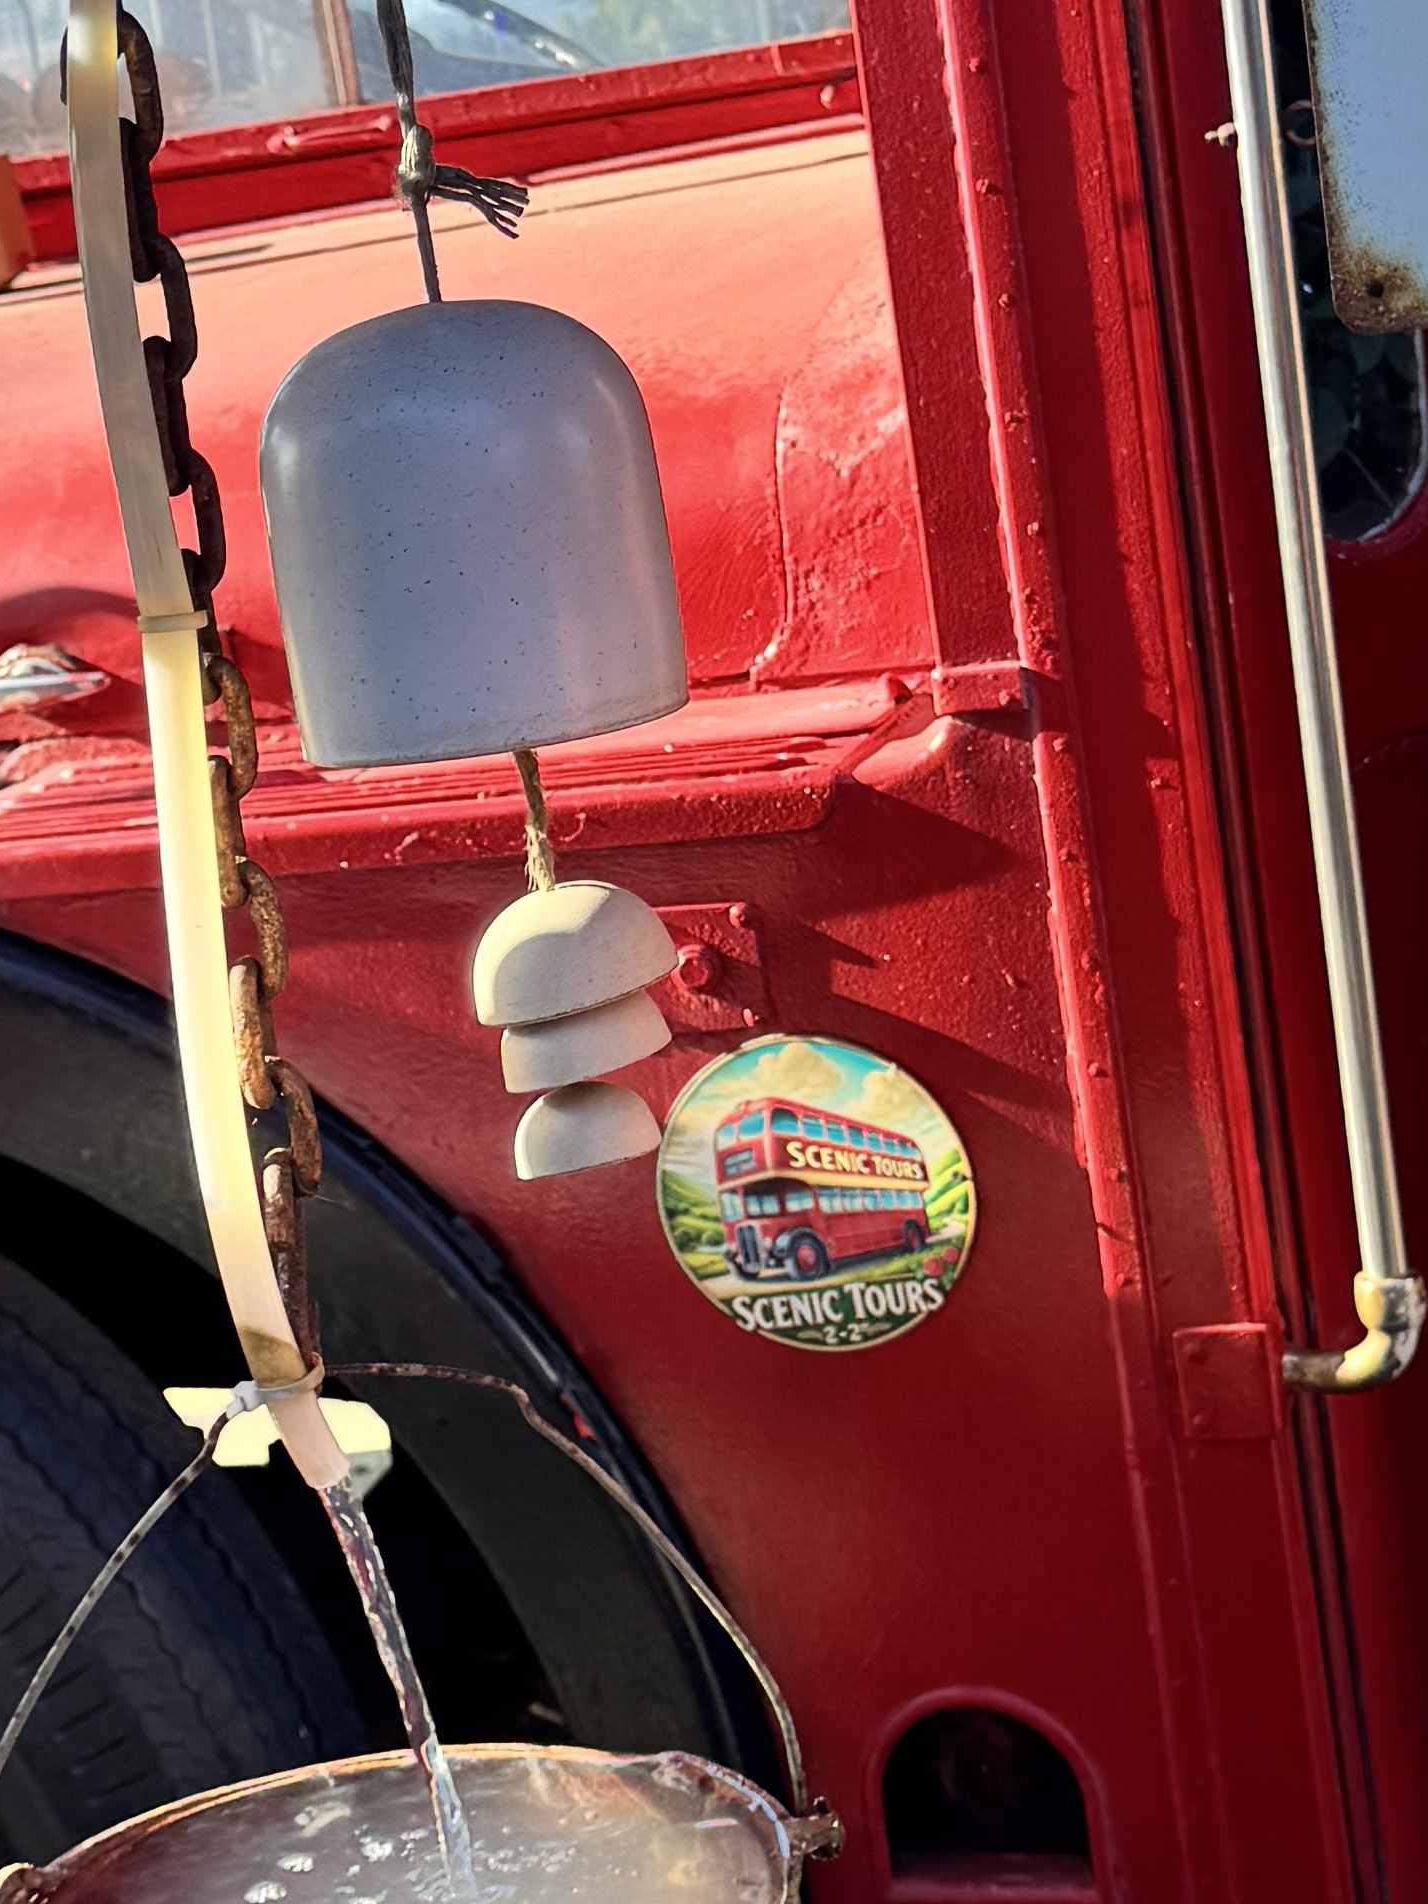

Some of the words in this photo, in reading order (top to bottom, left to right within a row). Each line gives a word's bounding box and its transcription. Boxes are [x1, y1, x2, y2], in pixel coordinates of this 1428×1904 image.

[785, 1140, 871, 1176] SCENIC
[871, 1155, 925, 1181] TOURS
[731, 1289, 844, 1333] SCENIC
[843, 1277, 946, 1320] TOURS
